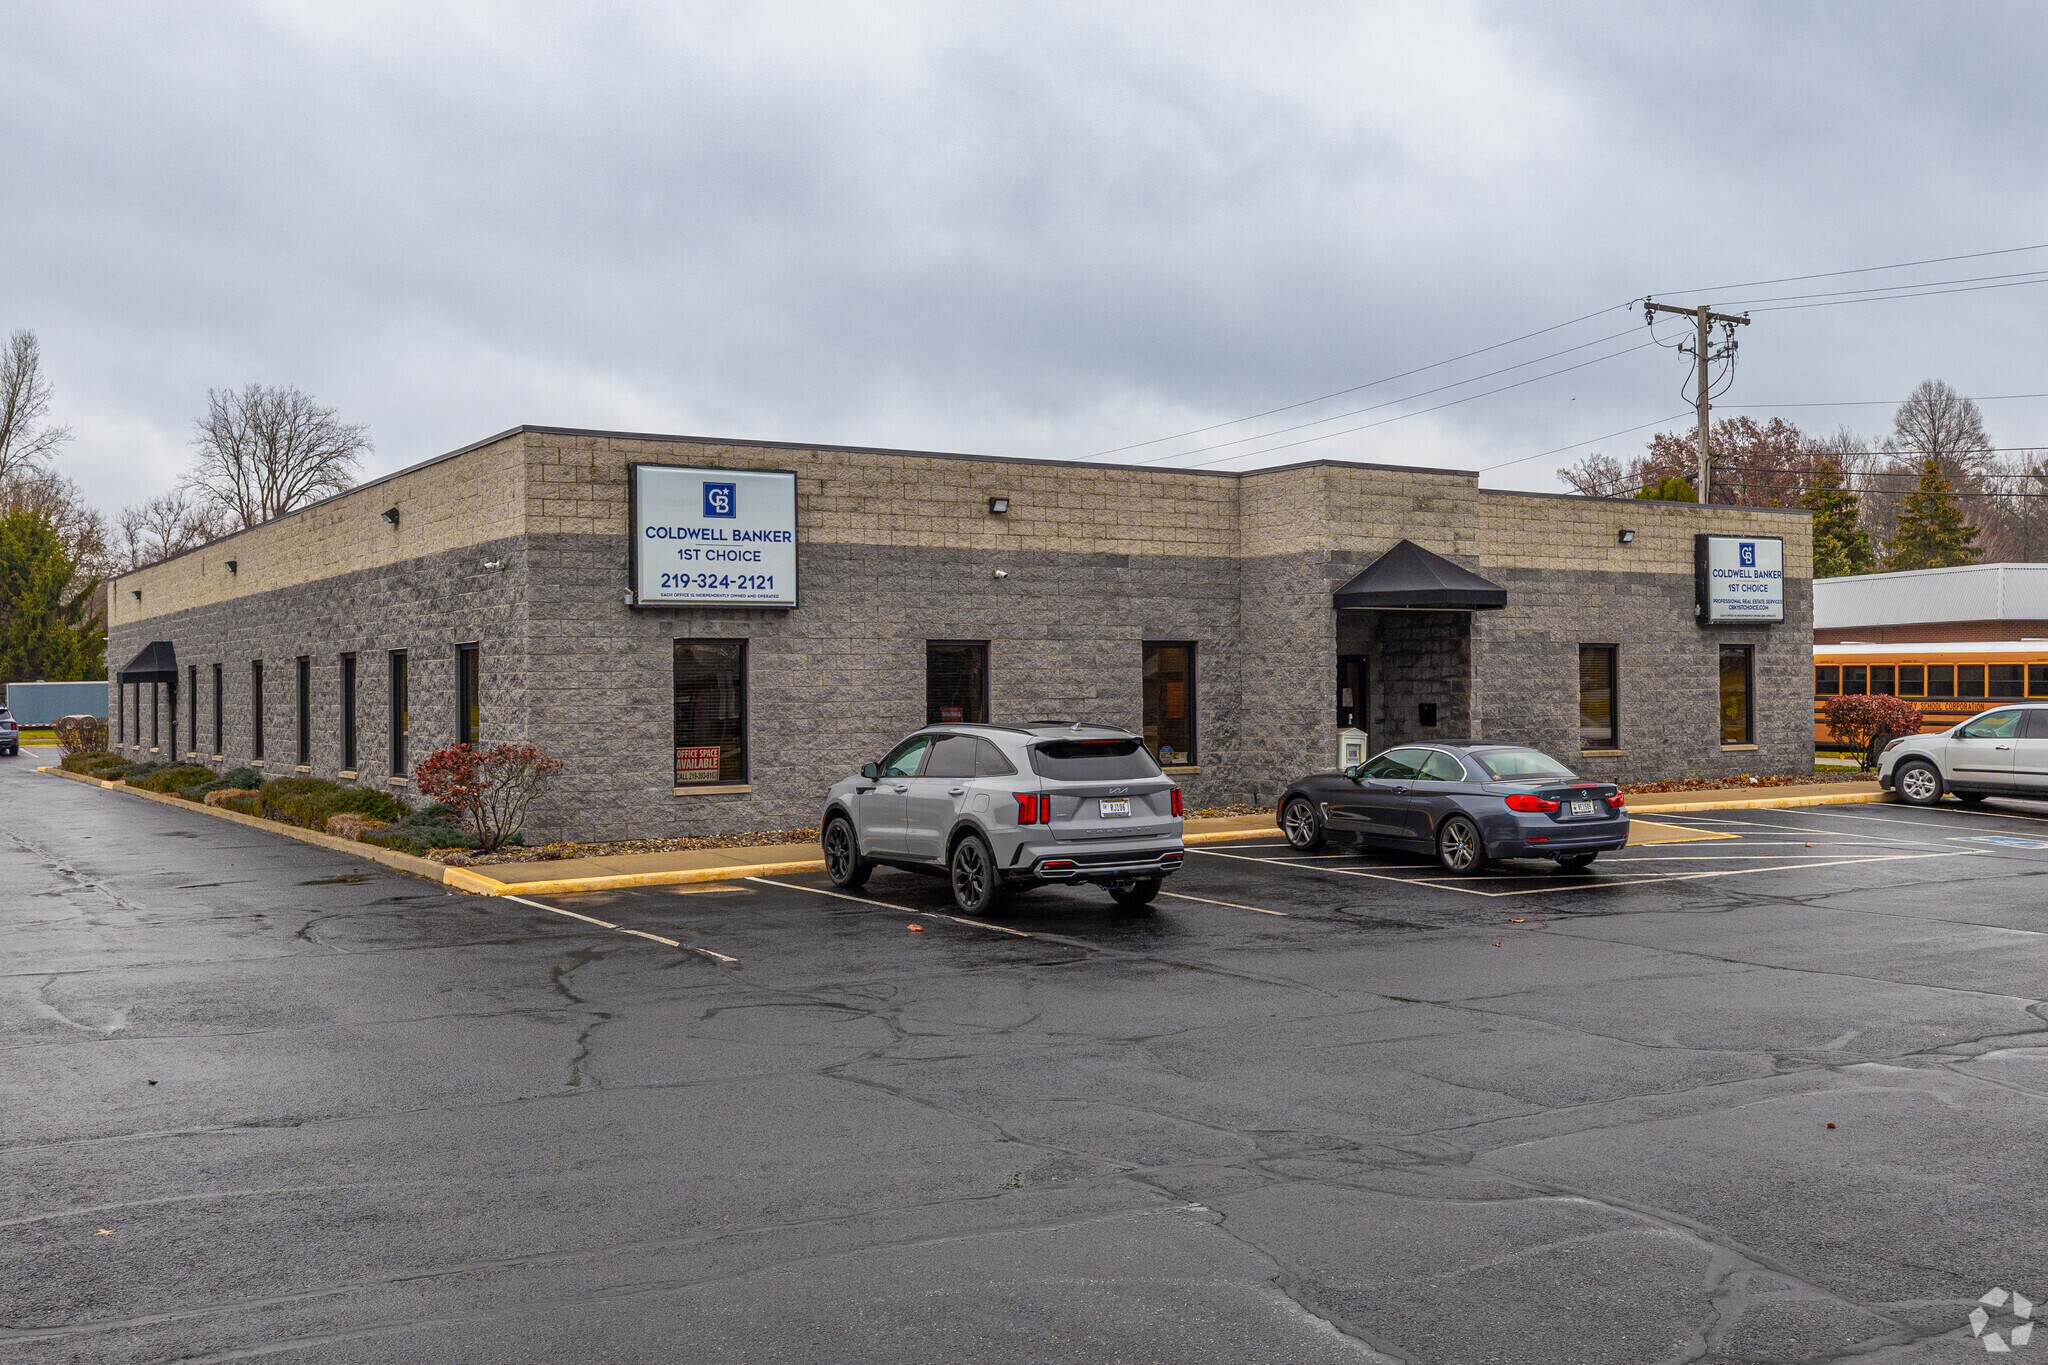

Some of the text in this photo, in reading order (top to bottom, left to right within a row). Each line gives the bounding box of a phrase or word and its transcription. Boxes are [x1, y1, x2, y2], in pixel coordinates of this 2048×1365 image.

[645, 526, 792, 543] COLDWELL BANKER
[677, 549, 761, 562] 1ST CHOICE
[1712, 569, 1782, 579] COLDWELL BANKER
[660, 573, 774, 590] 219-324-2121
[1728, 584, 1768, 593] 1ST CHOICE
[1920, 702, 1942, 711] SCHOOL
[1945, 702, 1985, 711] CORPORATION
[676, 749, 718, 758] OFFICE SPACE
[676, 758, 718, 769] AVAILABLE
